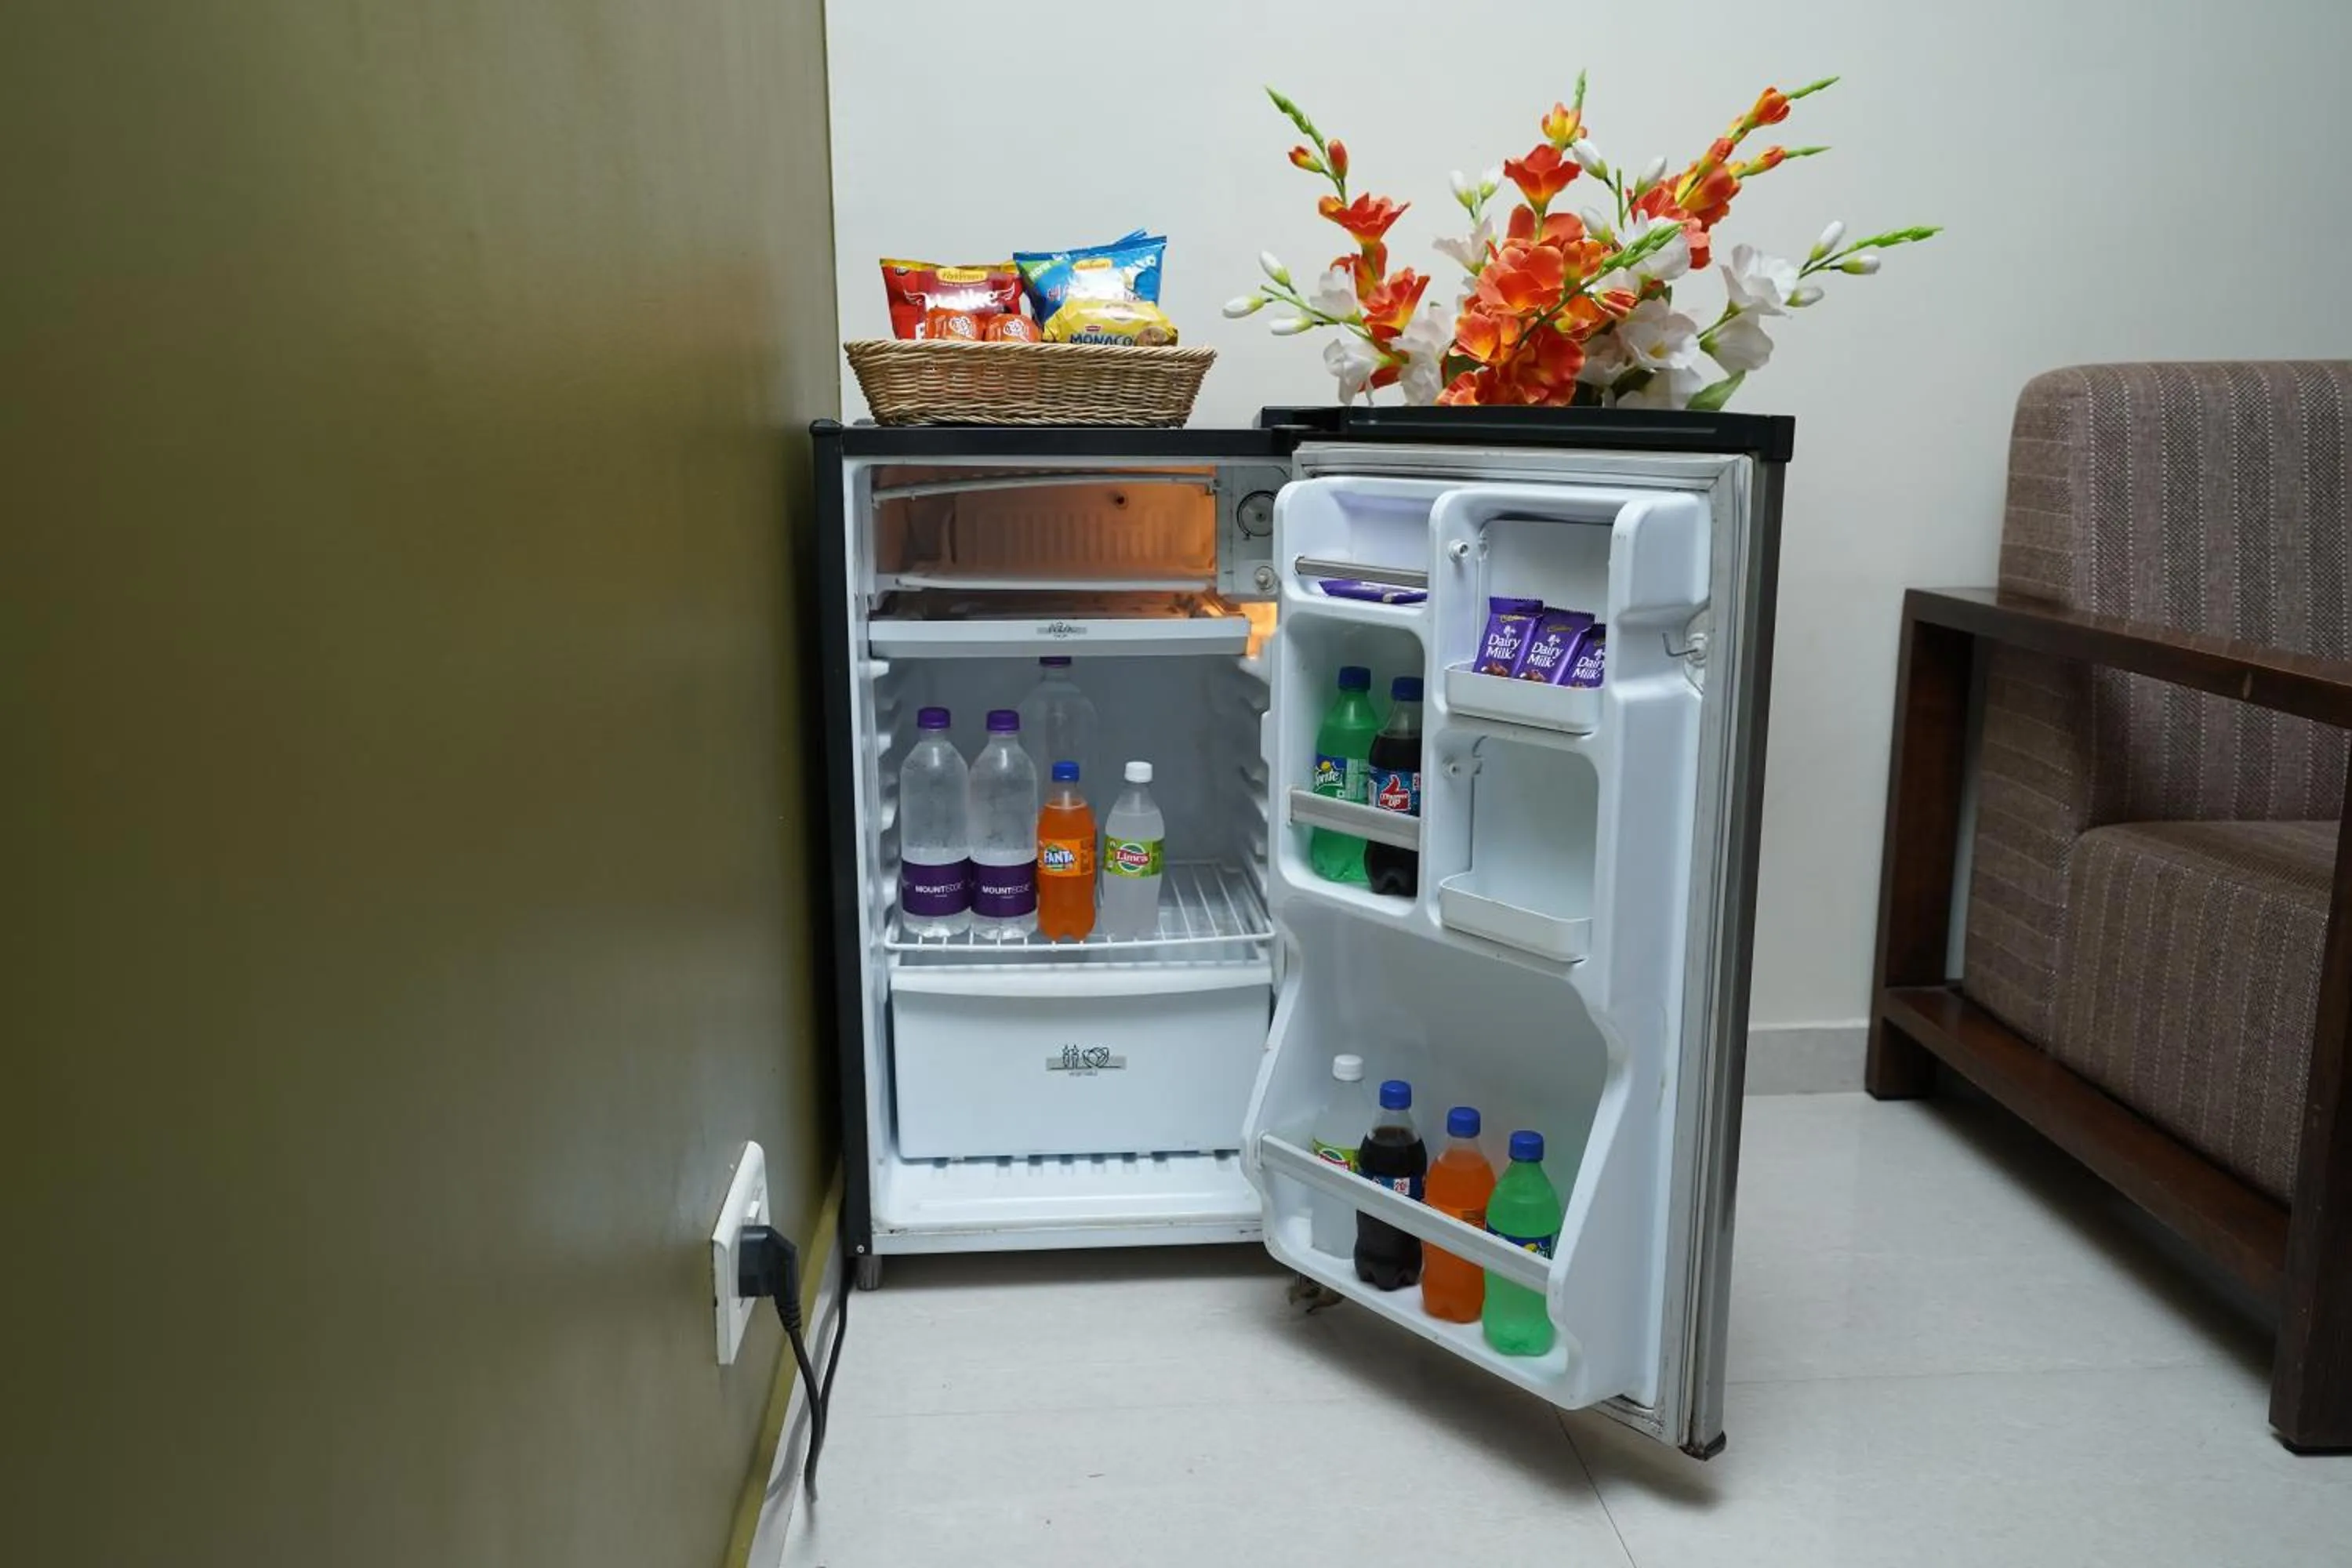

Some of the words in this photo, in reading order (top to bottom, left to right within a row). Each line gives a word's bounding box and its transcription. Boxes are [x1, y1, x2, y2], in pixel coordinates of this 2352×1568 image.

[1069, 333, 1134, 346] MONACO
[1488, 633, 1522, 648] Dairy
[1486, 646, 1515, 659] Milk
[1531, 642, 1564, 659] Dairy
[1527, 654, 1555, 667] Milk
[1572, 668, 1600, 680] Milk
[1044, 849, 1075, 863] FANTA
[1116, 851, 1149, 865] Limca
